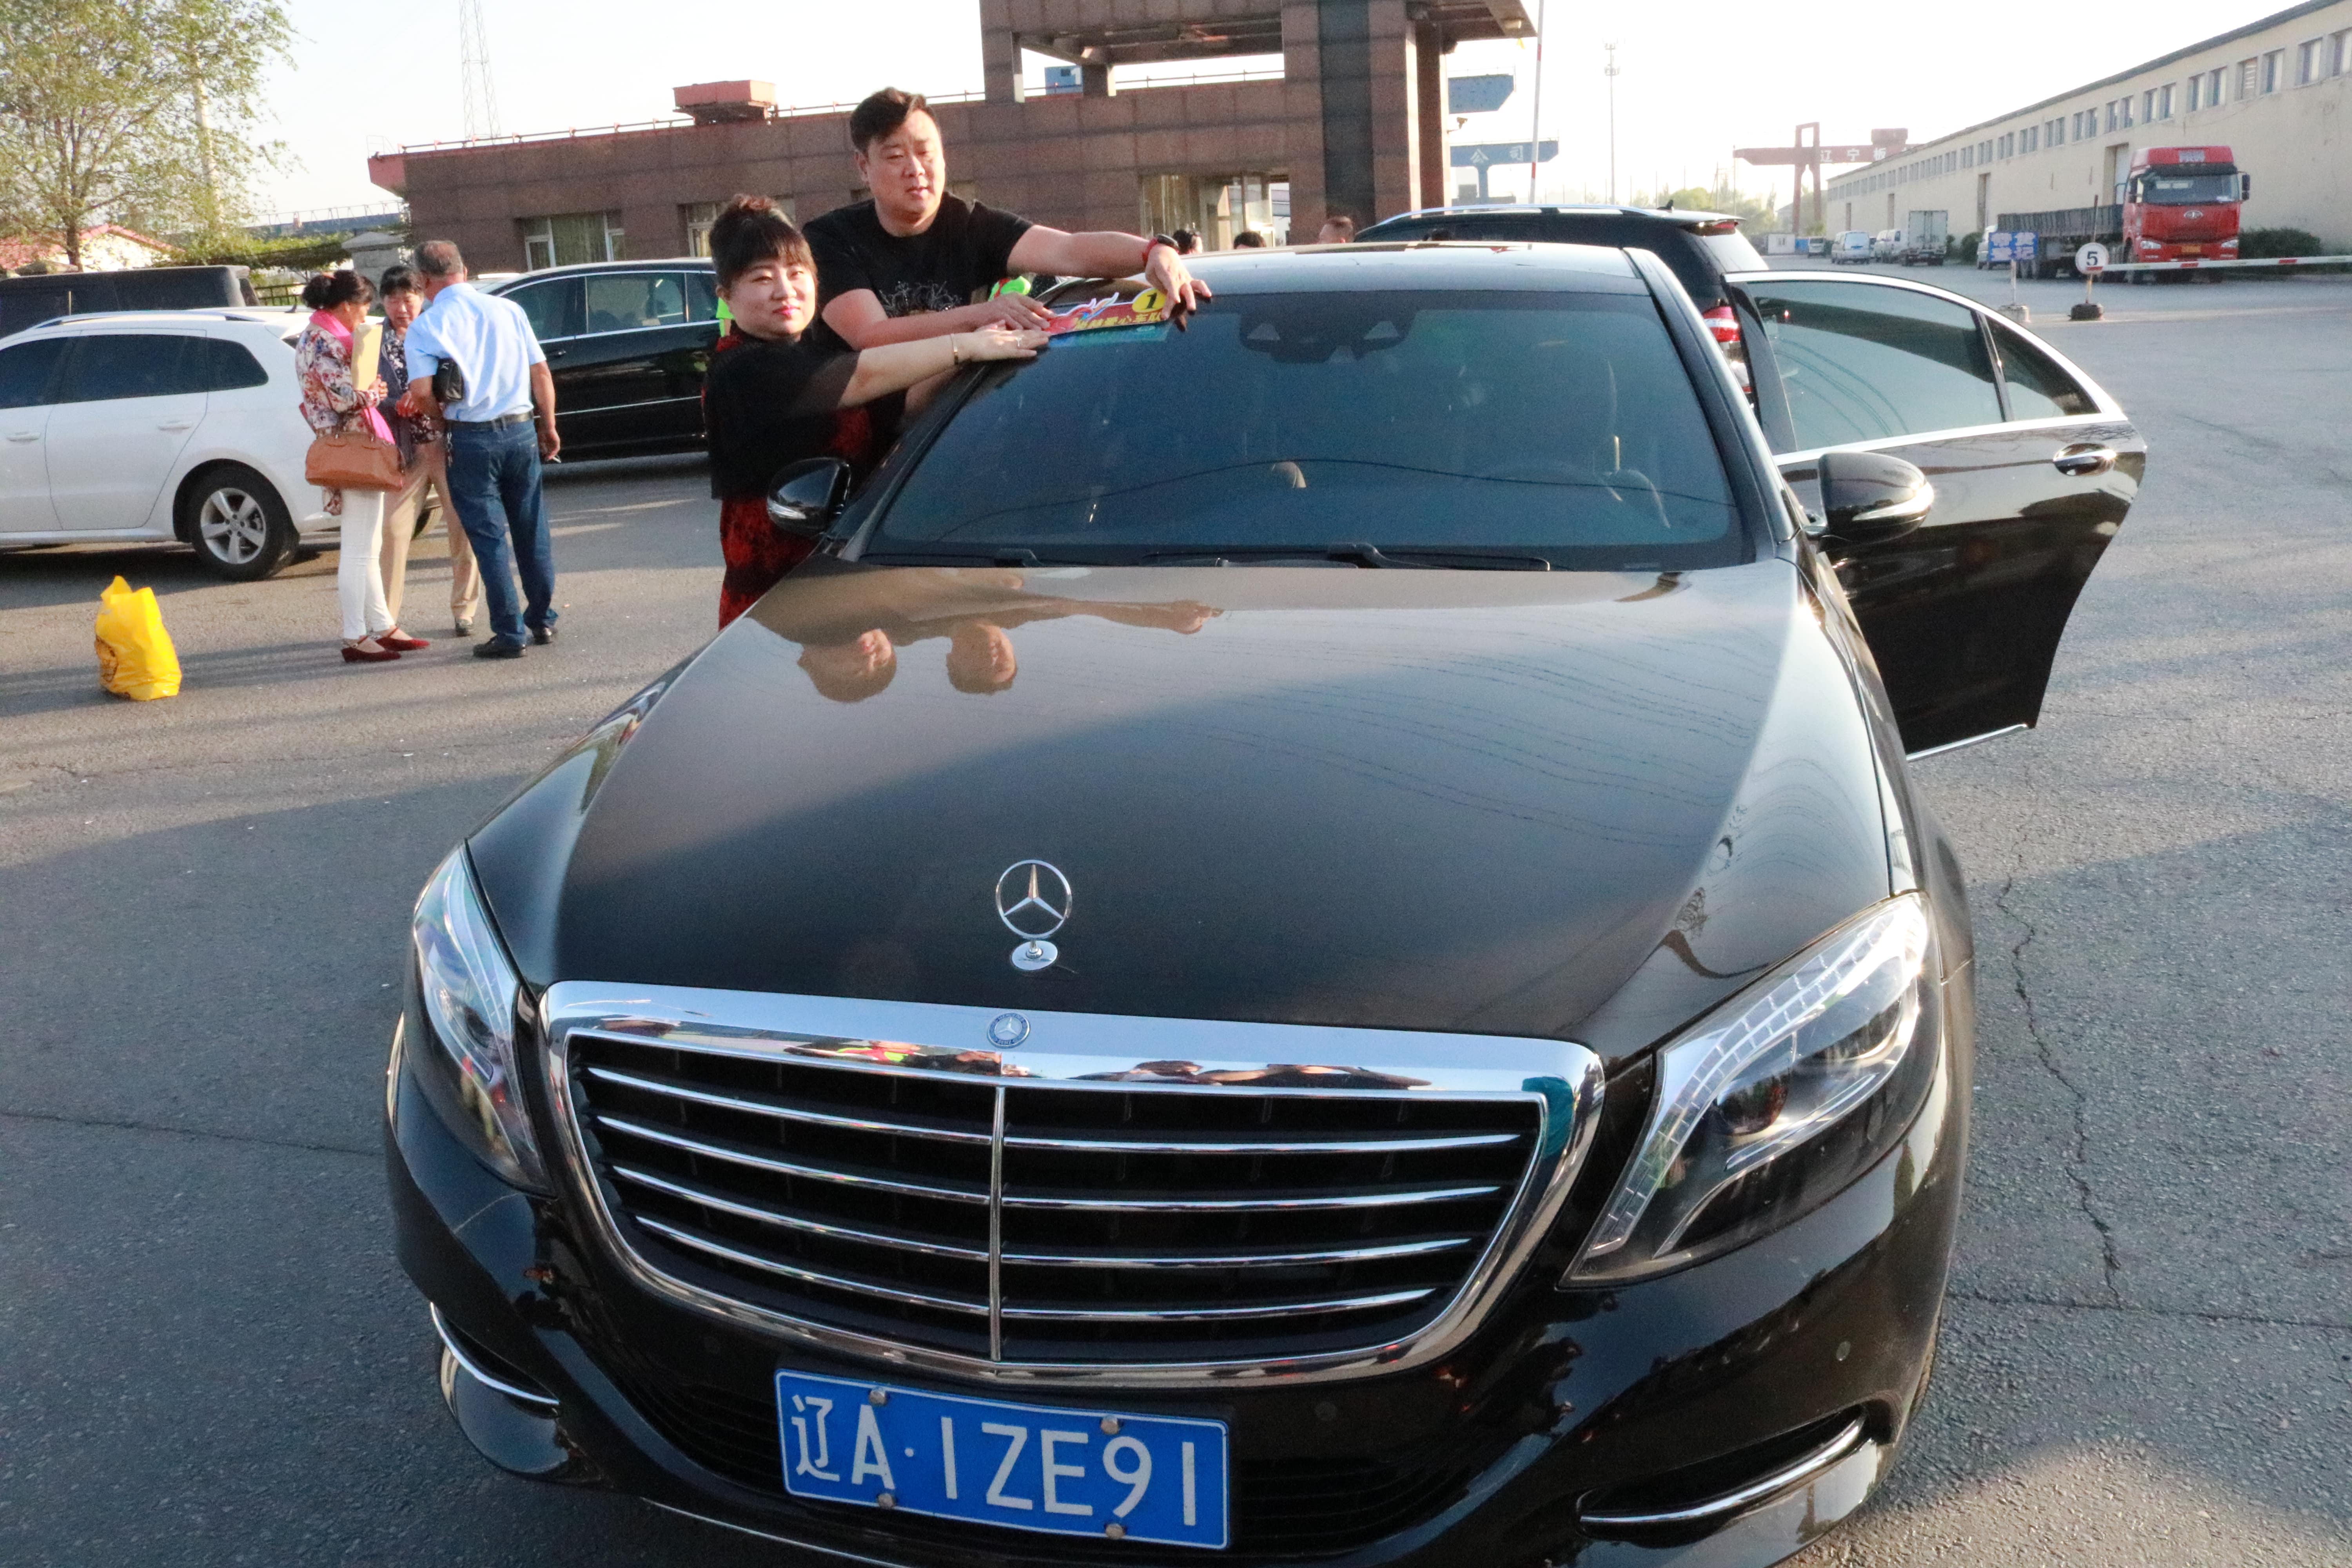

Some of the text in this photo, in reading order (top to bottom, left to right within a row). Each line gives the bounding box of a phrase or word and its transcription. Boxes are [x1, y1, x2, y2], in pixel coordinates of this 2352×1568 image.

[1470, 145, 1524, 164] 公司
[1820, 147, 1907, 163] 辽宁板
[2086, 251, 2098, 266] 5
[1146, 292, 1158, 309] 1
